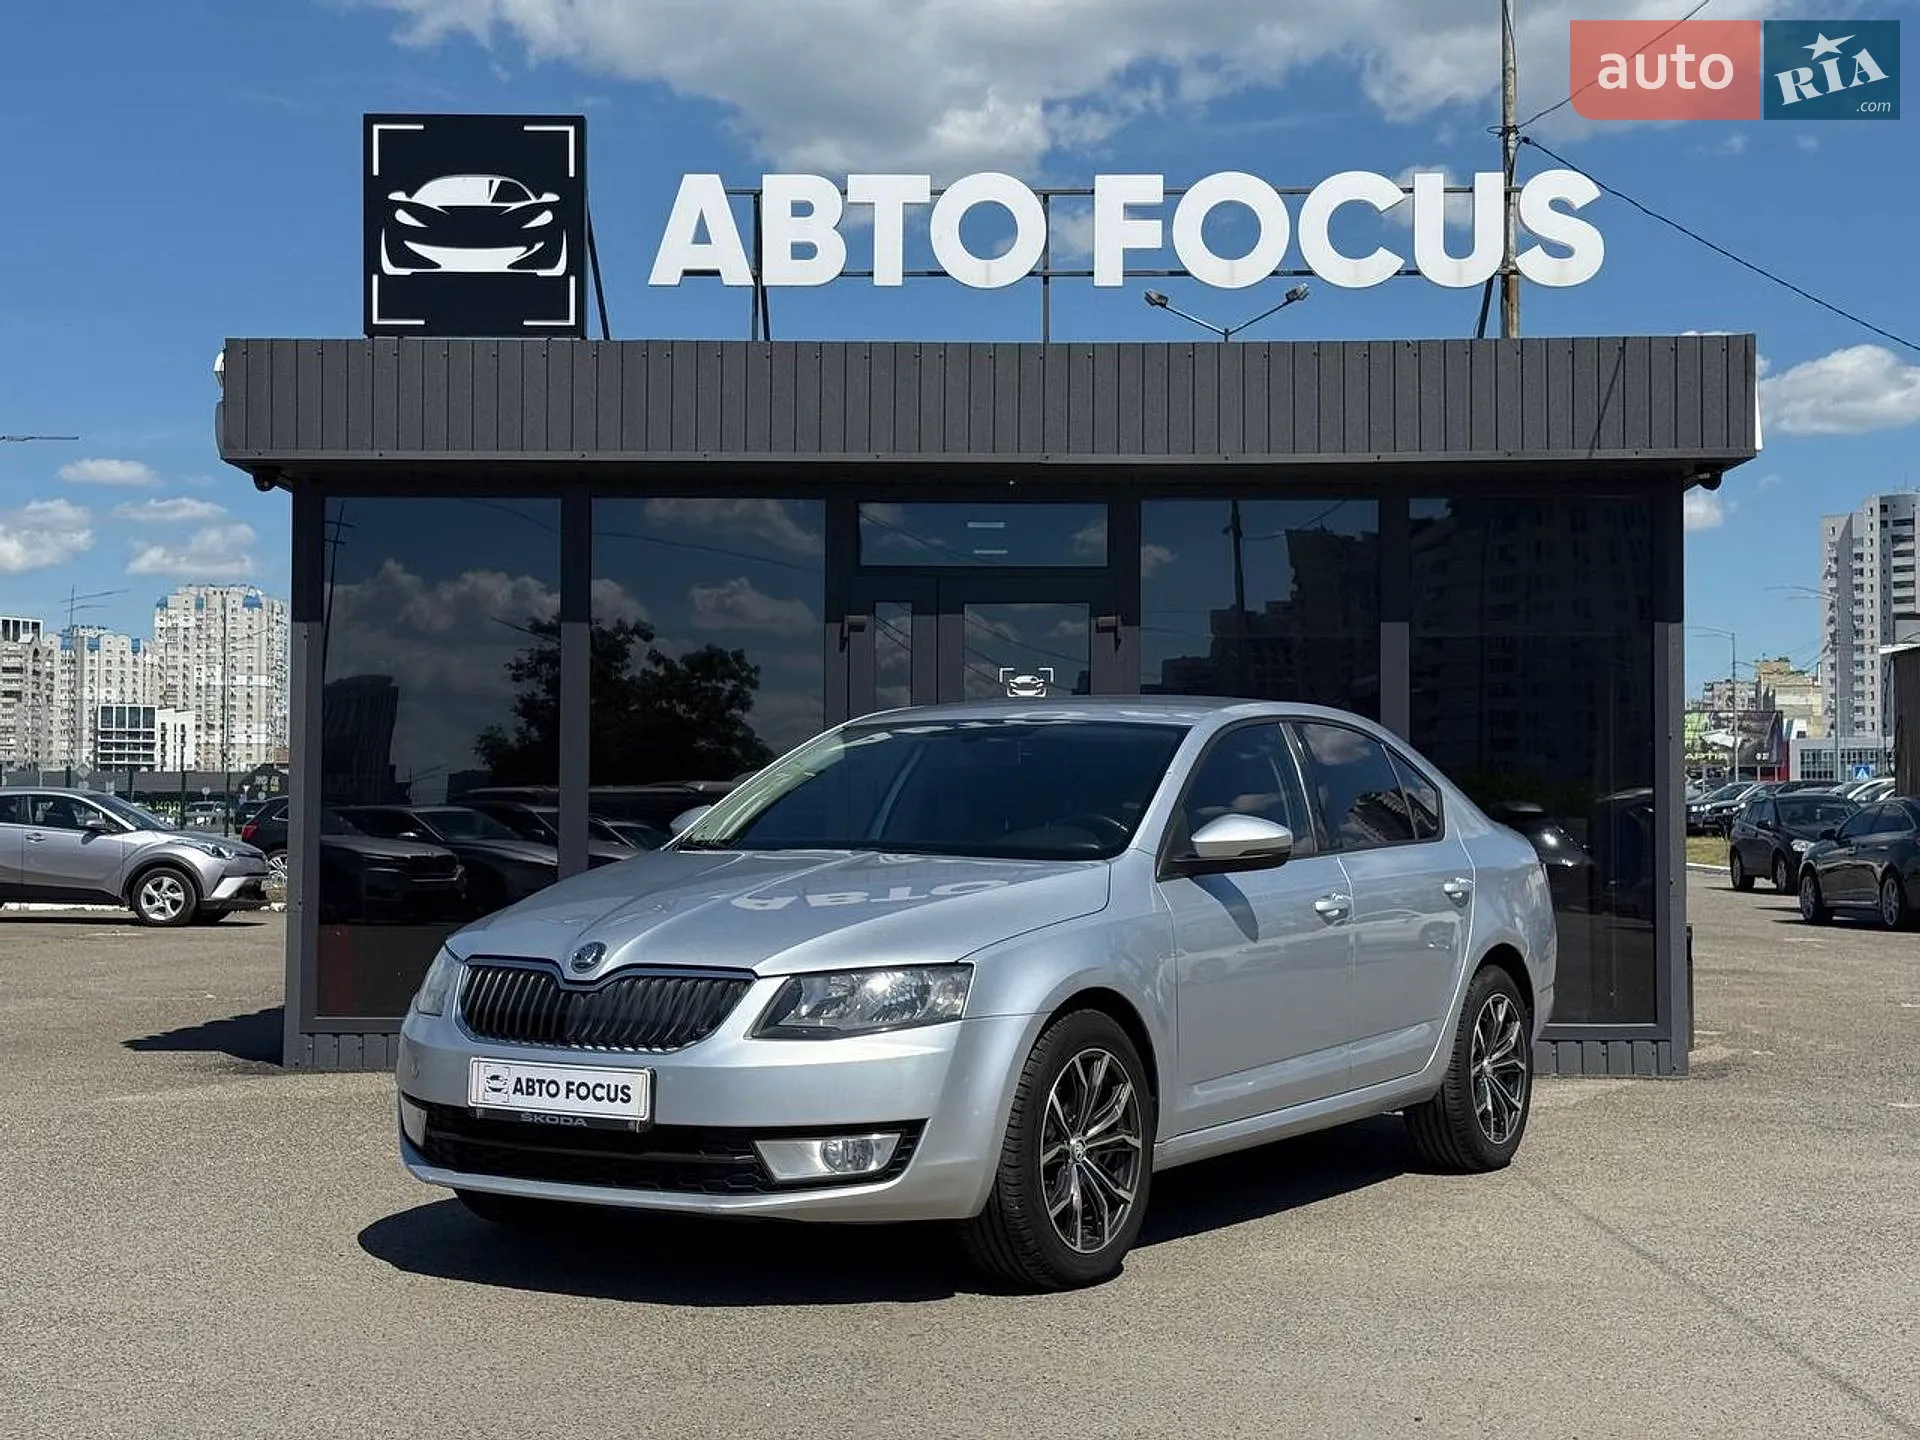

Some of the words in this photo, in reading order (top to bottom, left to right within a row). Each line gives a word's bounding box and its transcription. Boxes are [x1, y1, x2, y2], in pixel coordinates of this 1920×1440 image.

[648, 173, 1048, 288] АВТО
[1094, 171, 1605, 289] FOCUS
[512, 1076, 560, 1098] АВТО
[565, 1081, 632, 1103] FOCUS
